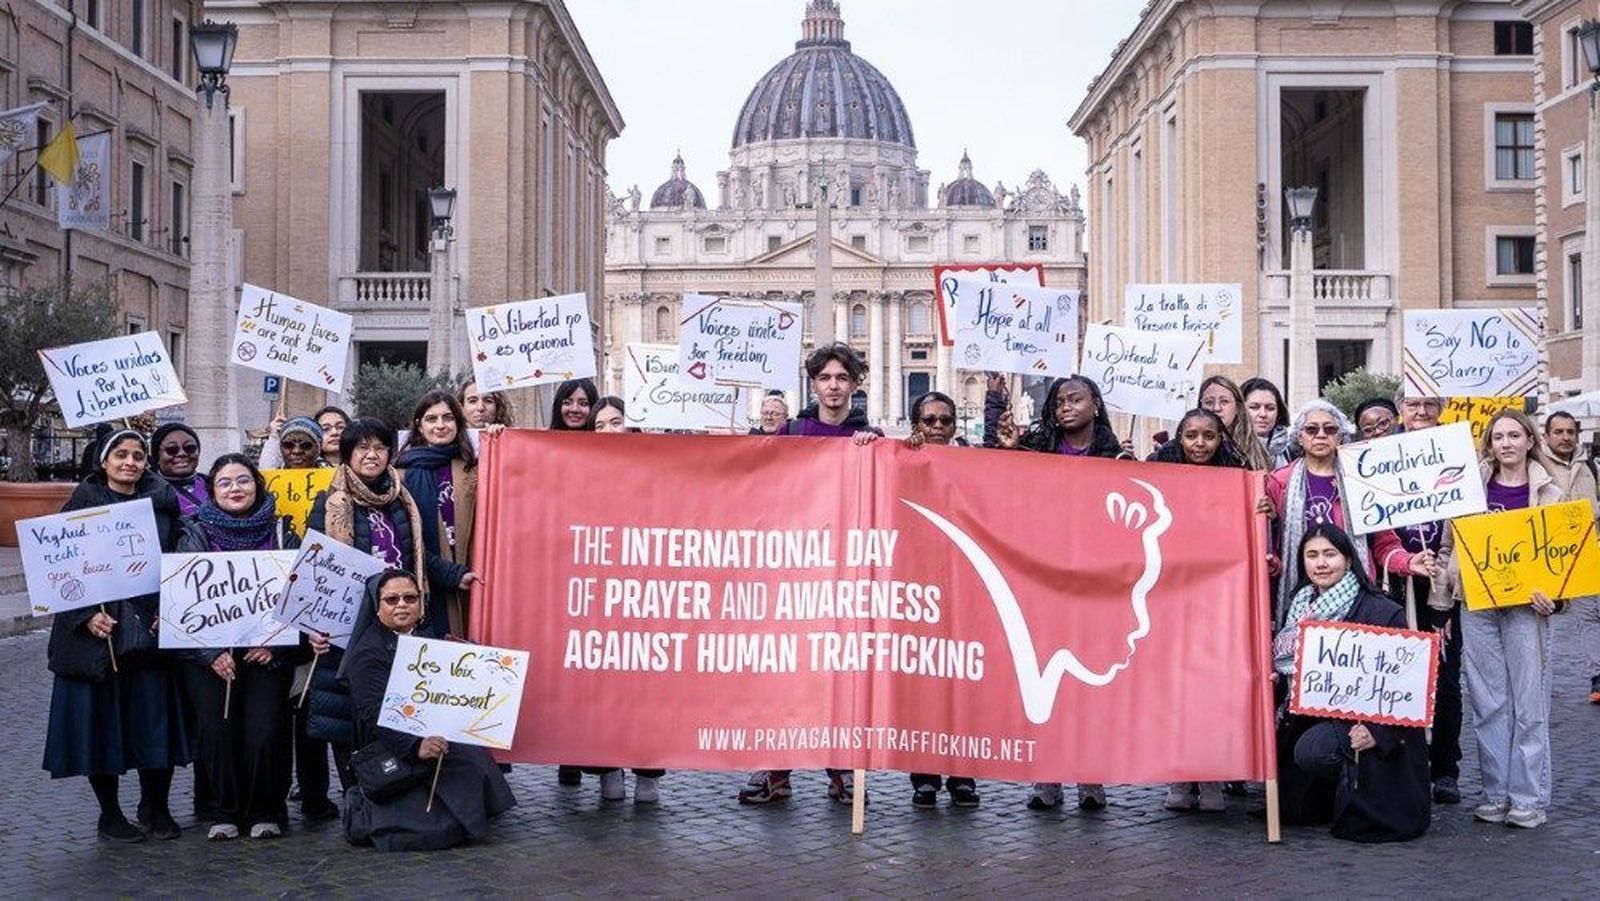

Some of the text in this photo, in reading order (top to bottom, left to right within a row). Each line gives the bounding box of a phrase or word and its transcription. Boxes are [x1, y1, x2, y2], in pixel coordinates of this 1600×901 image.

[252, 293, 340, 343] Human lives
[566, 313, 581, 328] no
[972, 288, 1013, 340] Hope
[1018, 300, 1032, 330] at
[1035, 305, 1052, 333] all
[1159, 293, 1189, 311] tratta
[1196, 294, 1207, 311] di
[257, 327, 323, 354] are not for
[700, 307, 740, 337] Voices
[1425, 325, 1461, 358] Say
[1470, 316, 1501, 349] No
[65, 340, 162, 378] Voces unidas
[495, 328, 575, 363] es opcional
[688, 342, 710, 360] for
[267, 379, 277, 391] P
[1431, 358, 1495, 388] Slavery
[76, 384, 150, 418] Libertad
[649, 378, 738, 412] Esperanza!
[1357, 438, 1445, 478] Condividi
[287, 482, 301, 502] to
[1361, 487, 1464, 526] Speranza
[570, 526, 898, 569] THE INTERNATIONAL DAY
[1477, 509, 1578, 577] Live Hope
[185, 557, 260, 604] Parla!
[180, 603, 244, 634] Salva
[567, 577, 941, 624] OF PRAYER AND AWARENESS
[407, 643, 477, 680] Les Voix
[564, 629, 985, 681] AGAINST HUMAN TRAFFICKING
[1318, 629, 1400, 675] Walk the
[1304, 670, 1413, 716] Path of Hope
[698, 726, 1036, 762] WWW.PRAYAGAINSTTRAFFICKING.NET
